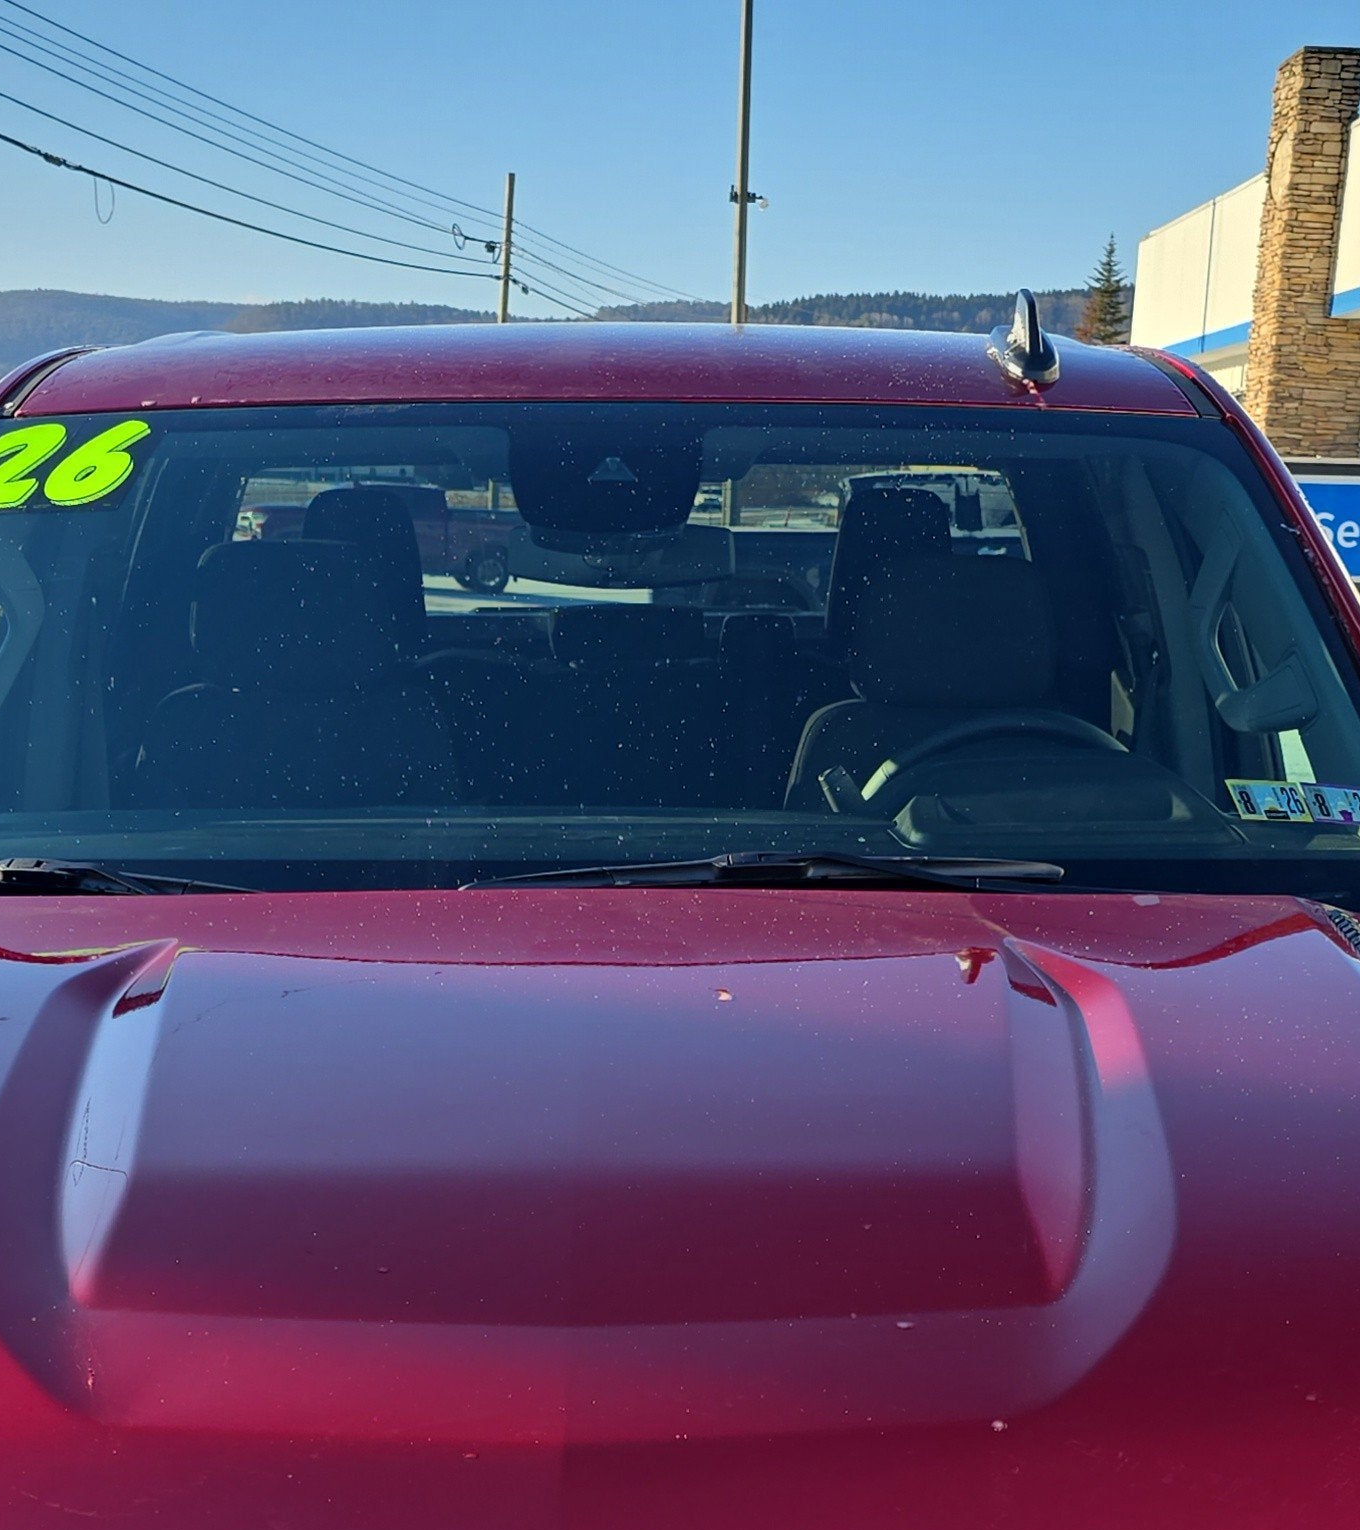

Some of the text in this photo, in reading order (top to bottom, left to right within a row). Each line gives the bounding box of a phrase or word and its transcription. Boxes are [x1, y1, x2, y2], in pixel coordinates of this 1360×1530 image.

[1238, 787, 1306, 814] 8 26
[1313, 793, 1331, 817] 8
